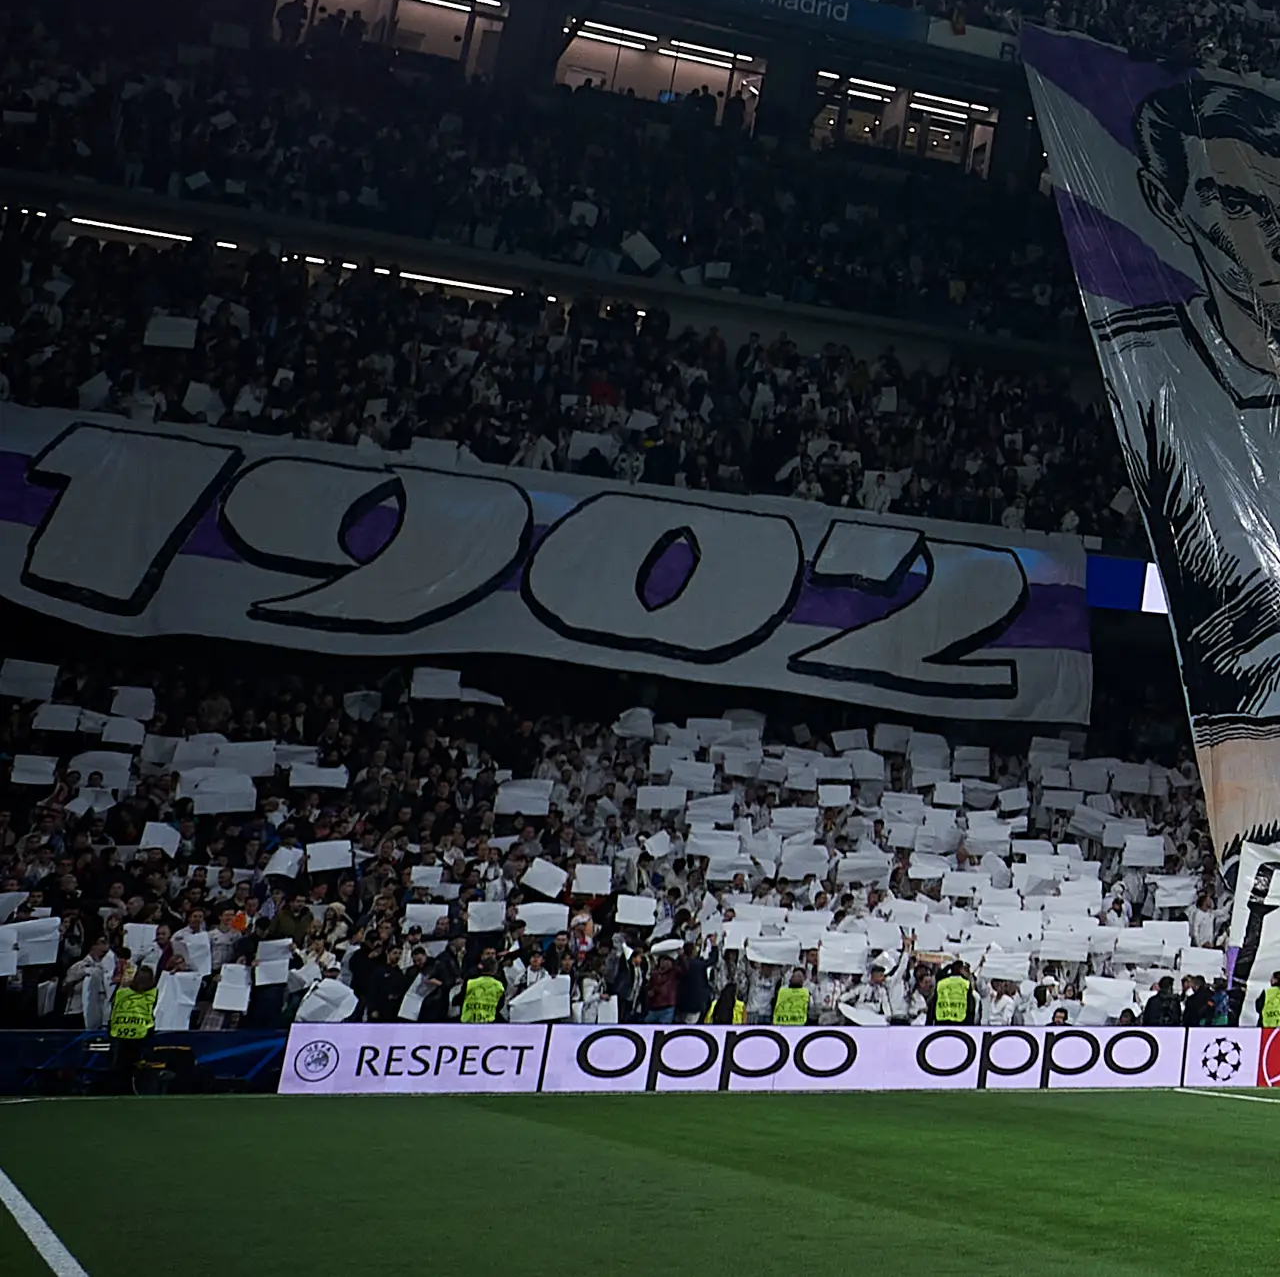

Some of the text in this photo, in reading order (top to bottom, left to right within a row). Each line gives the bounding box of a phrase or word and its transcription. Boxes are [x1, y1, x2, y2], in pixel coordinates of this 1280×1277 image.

[20, 421, 1018, 699] 1902
[355, 1044, 534, 1077] RESPECT
[577, 1028, 857, 1092] oppo
[916, 1029, 1159, 1090] oppo
